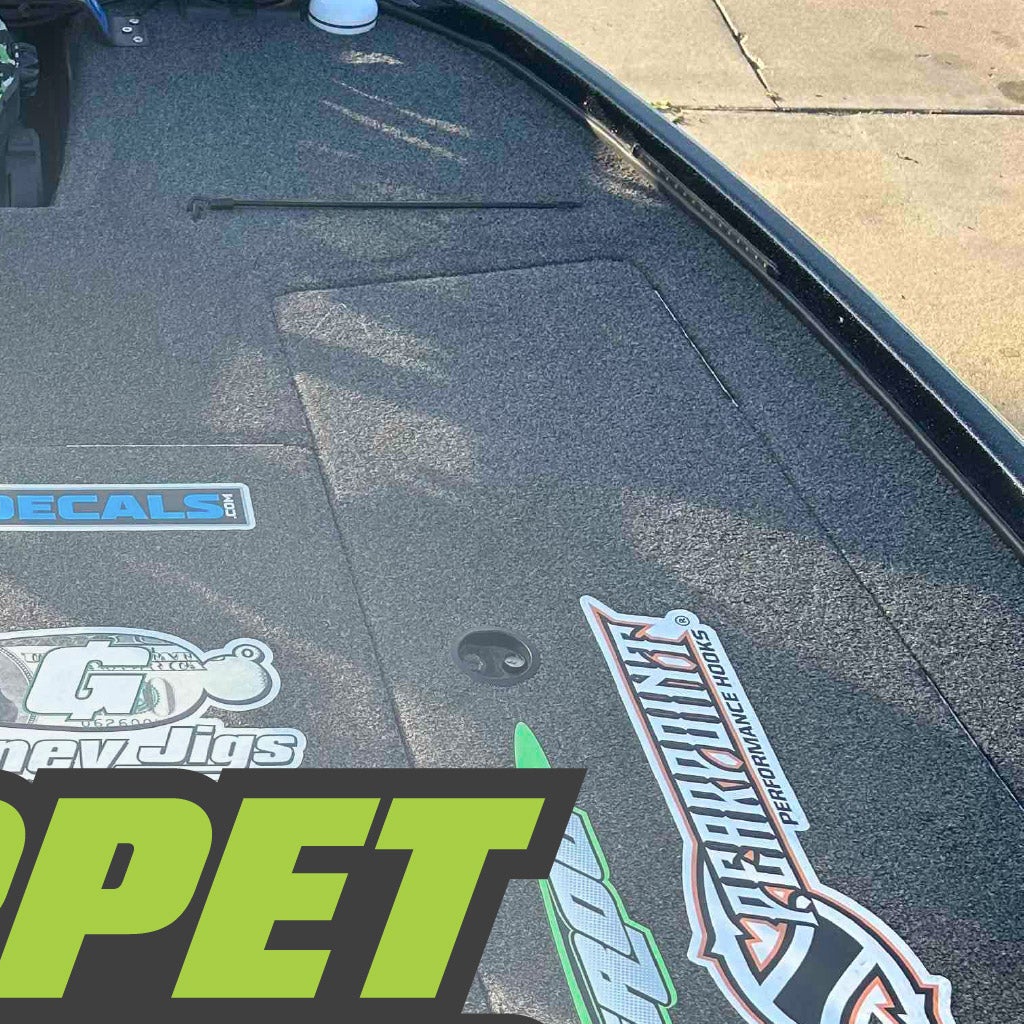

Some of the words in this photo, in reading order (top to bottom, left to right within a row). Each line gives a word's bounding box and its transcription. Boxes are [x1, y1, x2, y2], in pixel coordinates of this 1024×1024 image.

[24, 640, 152, 722] G
[690, 628, 734, 688] HOOKS
[725, 690, 799, 827] PERFORMANCE
